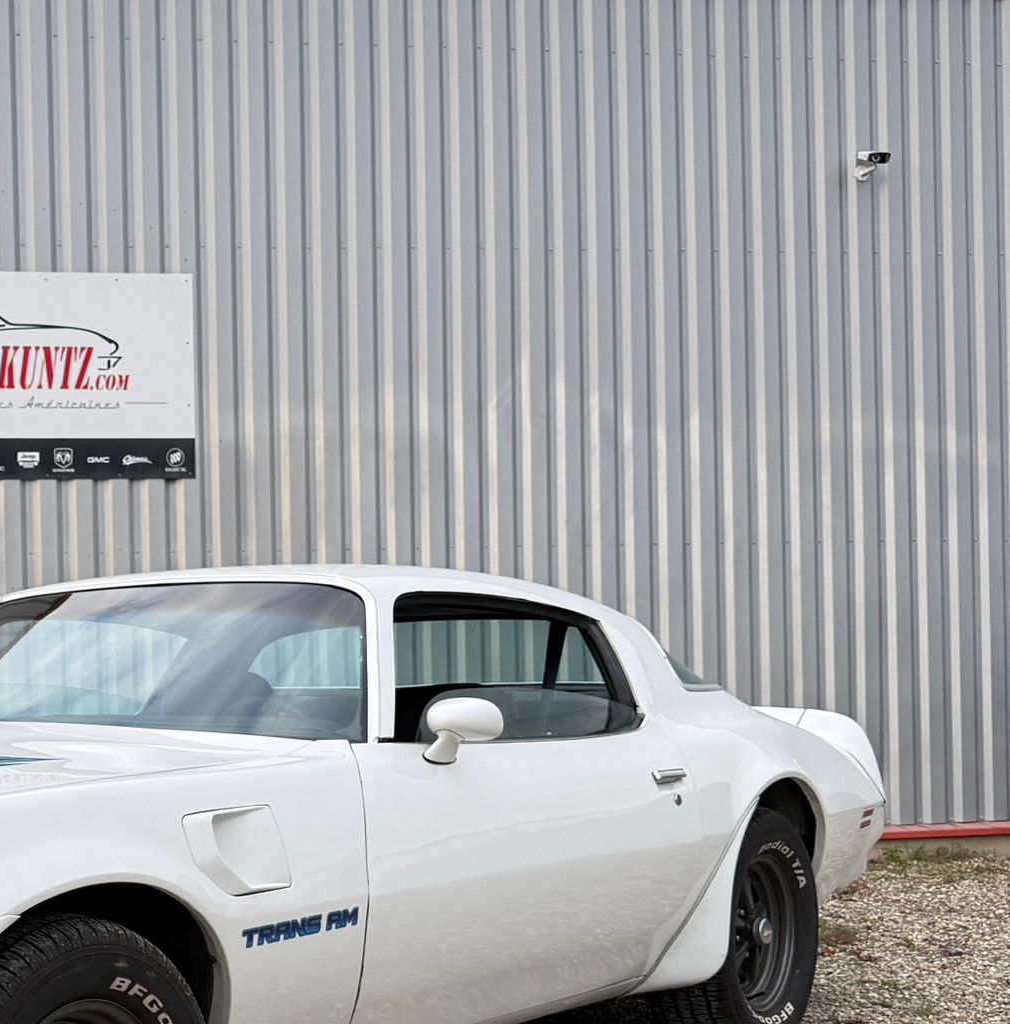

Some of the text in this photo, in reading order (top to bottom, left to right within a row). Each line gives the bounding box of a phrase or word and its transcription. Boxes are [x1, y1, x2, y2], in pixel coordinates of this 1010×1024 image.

[18, 395, 121, 410] Américaines
[87, 456, 110, 464] GMC
[242, 906, 359, 949] TRANS AM
